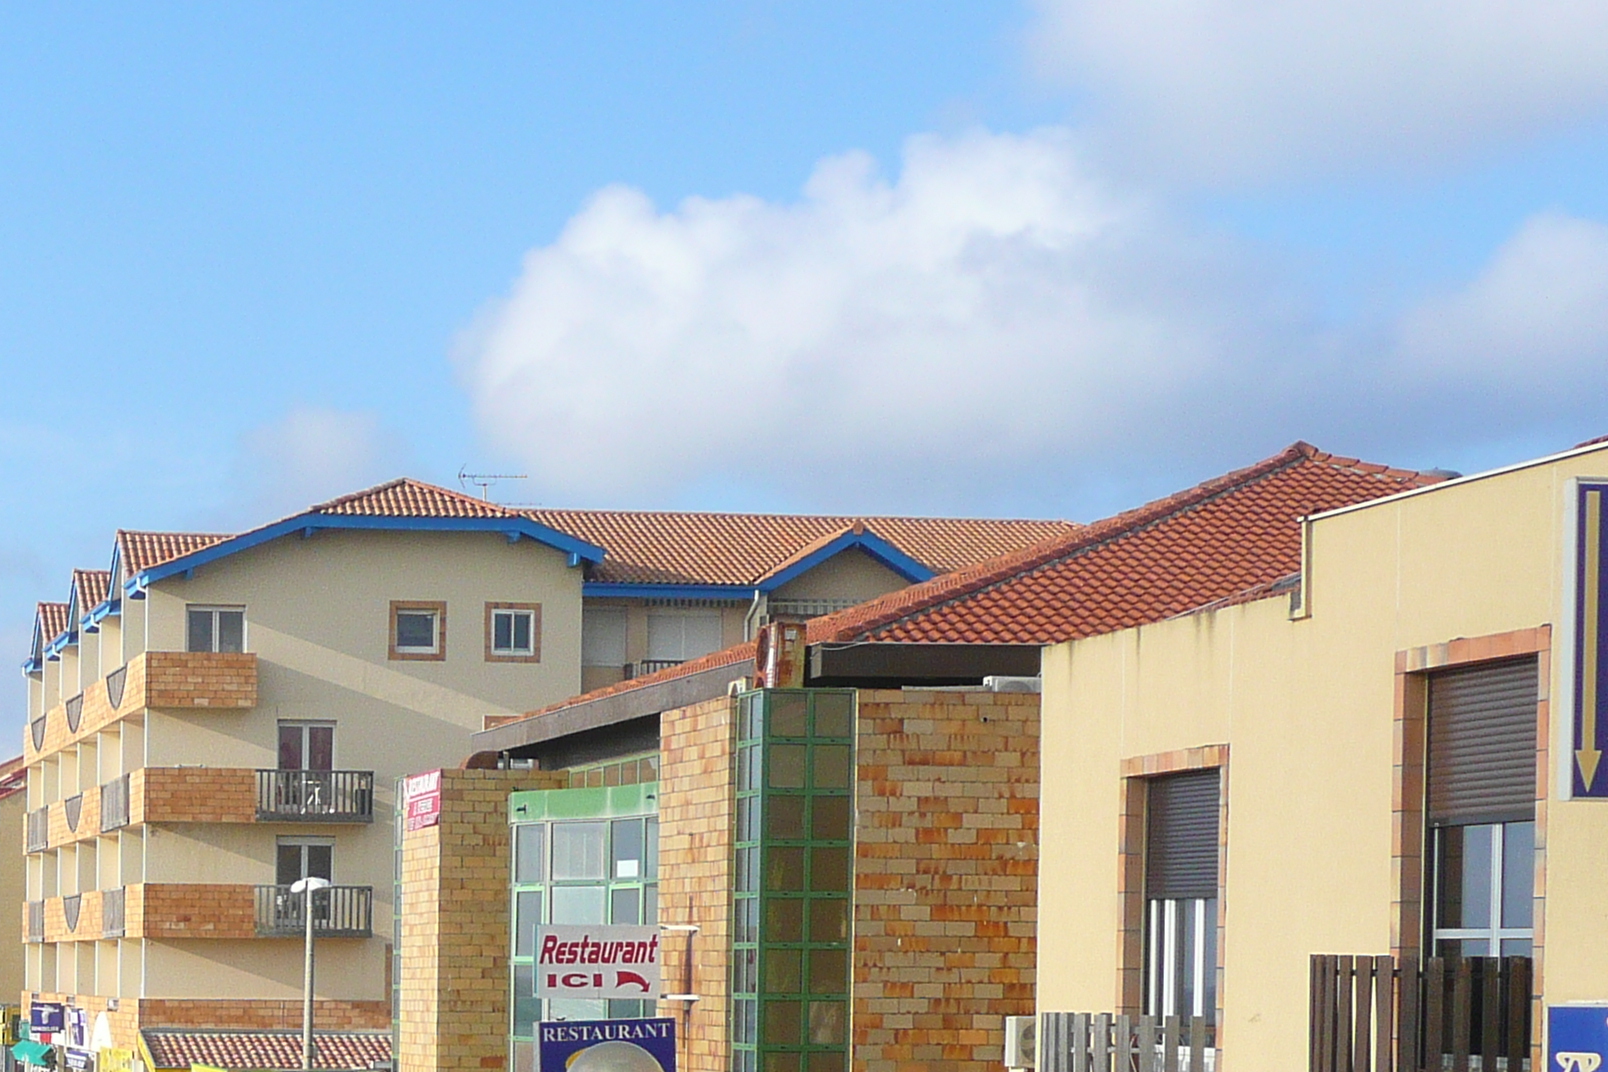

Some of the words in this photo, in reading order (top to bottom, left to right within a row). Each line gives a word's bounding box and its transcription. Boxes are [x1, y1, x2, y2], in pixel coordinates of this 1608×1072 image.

[539, 934, 659, 964] Restaurant
[547, 973, 603, 988] ICI
[543, 1023, 671, 1042] RESTAURANT
